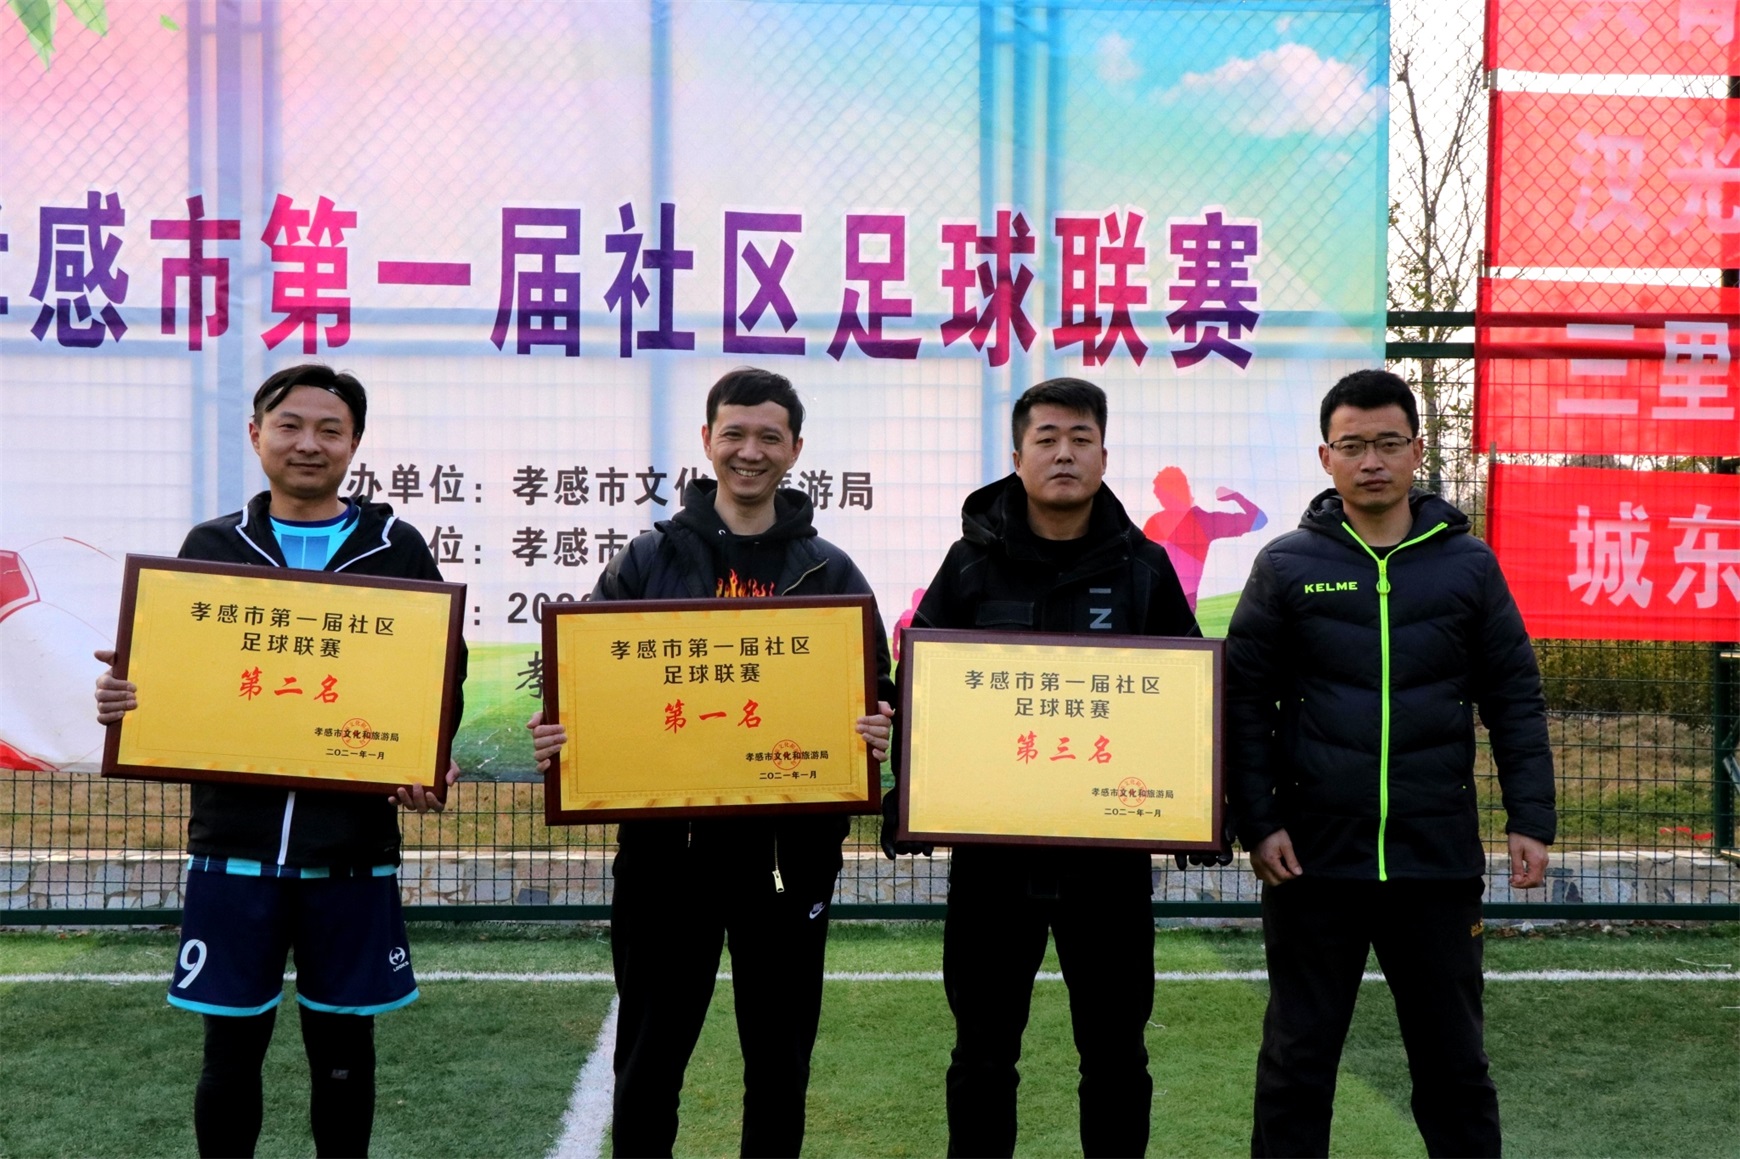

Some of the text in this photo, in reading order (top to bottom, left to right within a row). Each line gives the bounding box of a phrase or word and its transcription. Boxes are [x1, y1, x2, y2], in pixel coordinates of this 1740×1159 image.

[0, 190, 1260, 369] 感市第一届社区足球联赛
[1557, 321, 1735, 420] 三里
[1567, 501, 1740, 608] 城东
[1304, 581, 1358, 594] KELME
[190, 601, 395, 636] 孝感市第一届社区
[240, 633, 341, 659] 足球联赛
[611, 635, 811, 660] 孝感市第一届社区
[238, 666, 340, 704] 第二名
[663, 662, 761, 685] 足球联赛
[964, 670, 1160, 695] 孝感市第一届社区
[664, 698, 762, 734] 第一名
[1014, 697, 1110, 720] 足球联赛
[314, 727, 400, 742] 孝感市文化和旅游局
[745, 750, 829, 762] 孝感市文化和旅游局
[1016, 731, 1112, 765] 第三名
[1091, 787, 1174, 799] 孝感市文化和旅游局
[177, 938, 208, 989] 9
